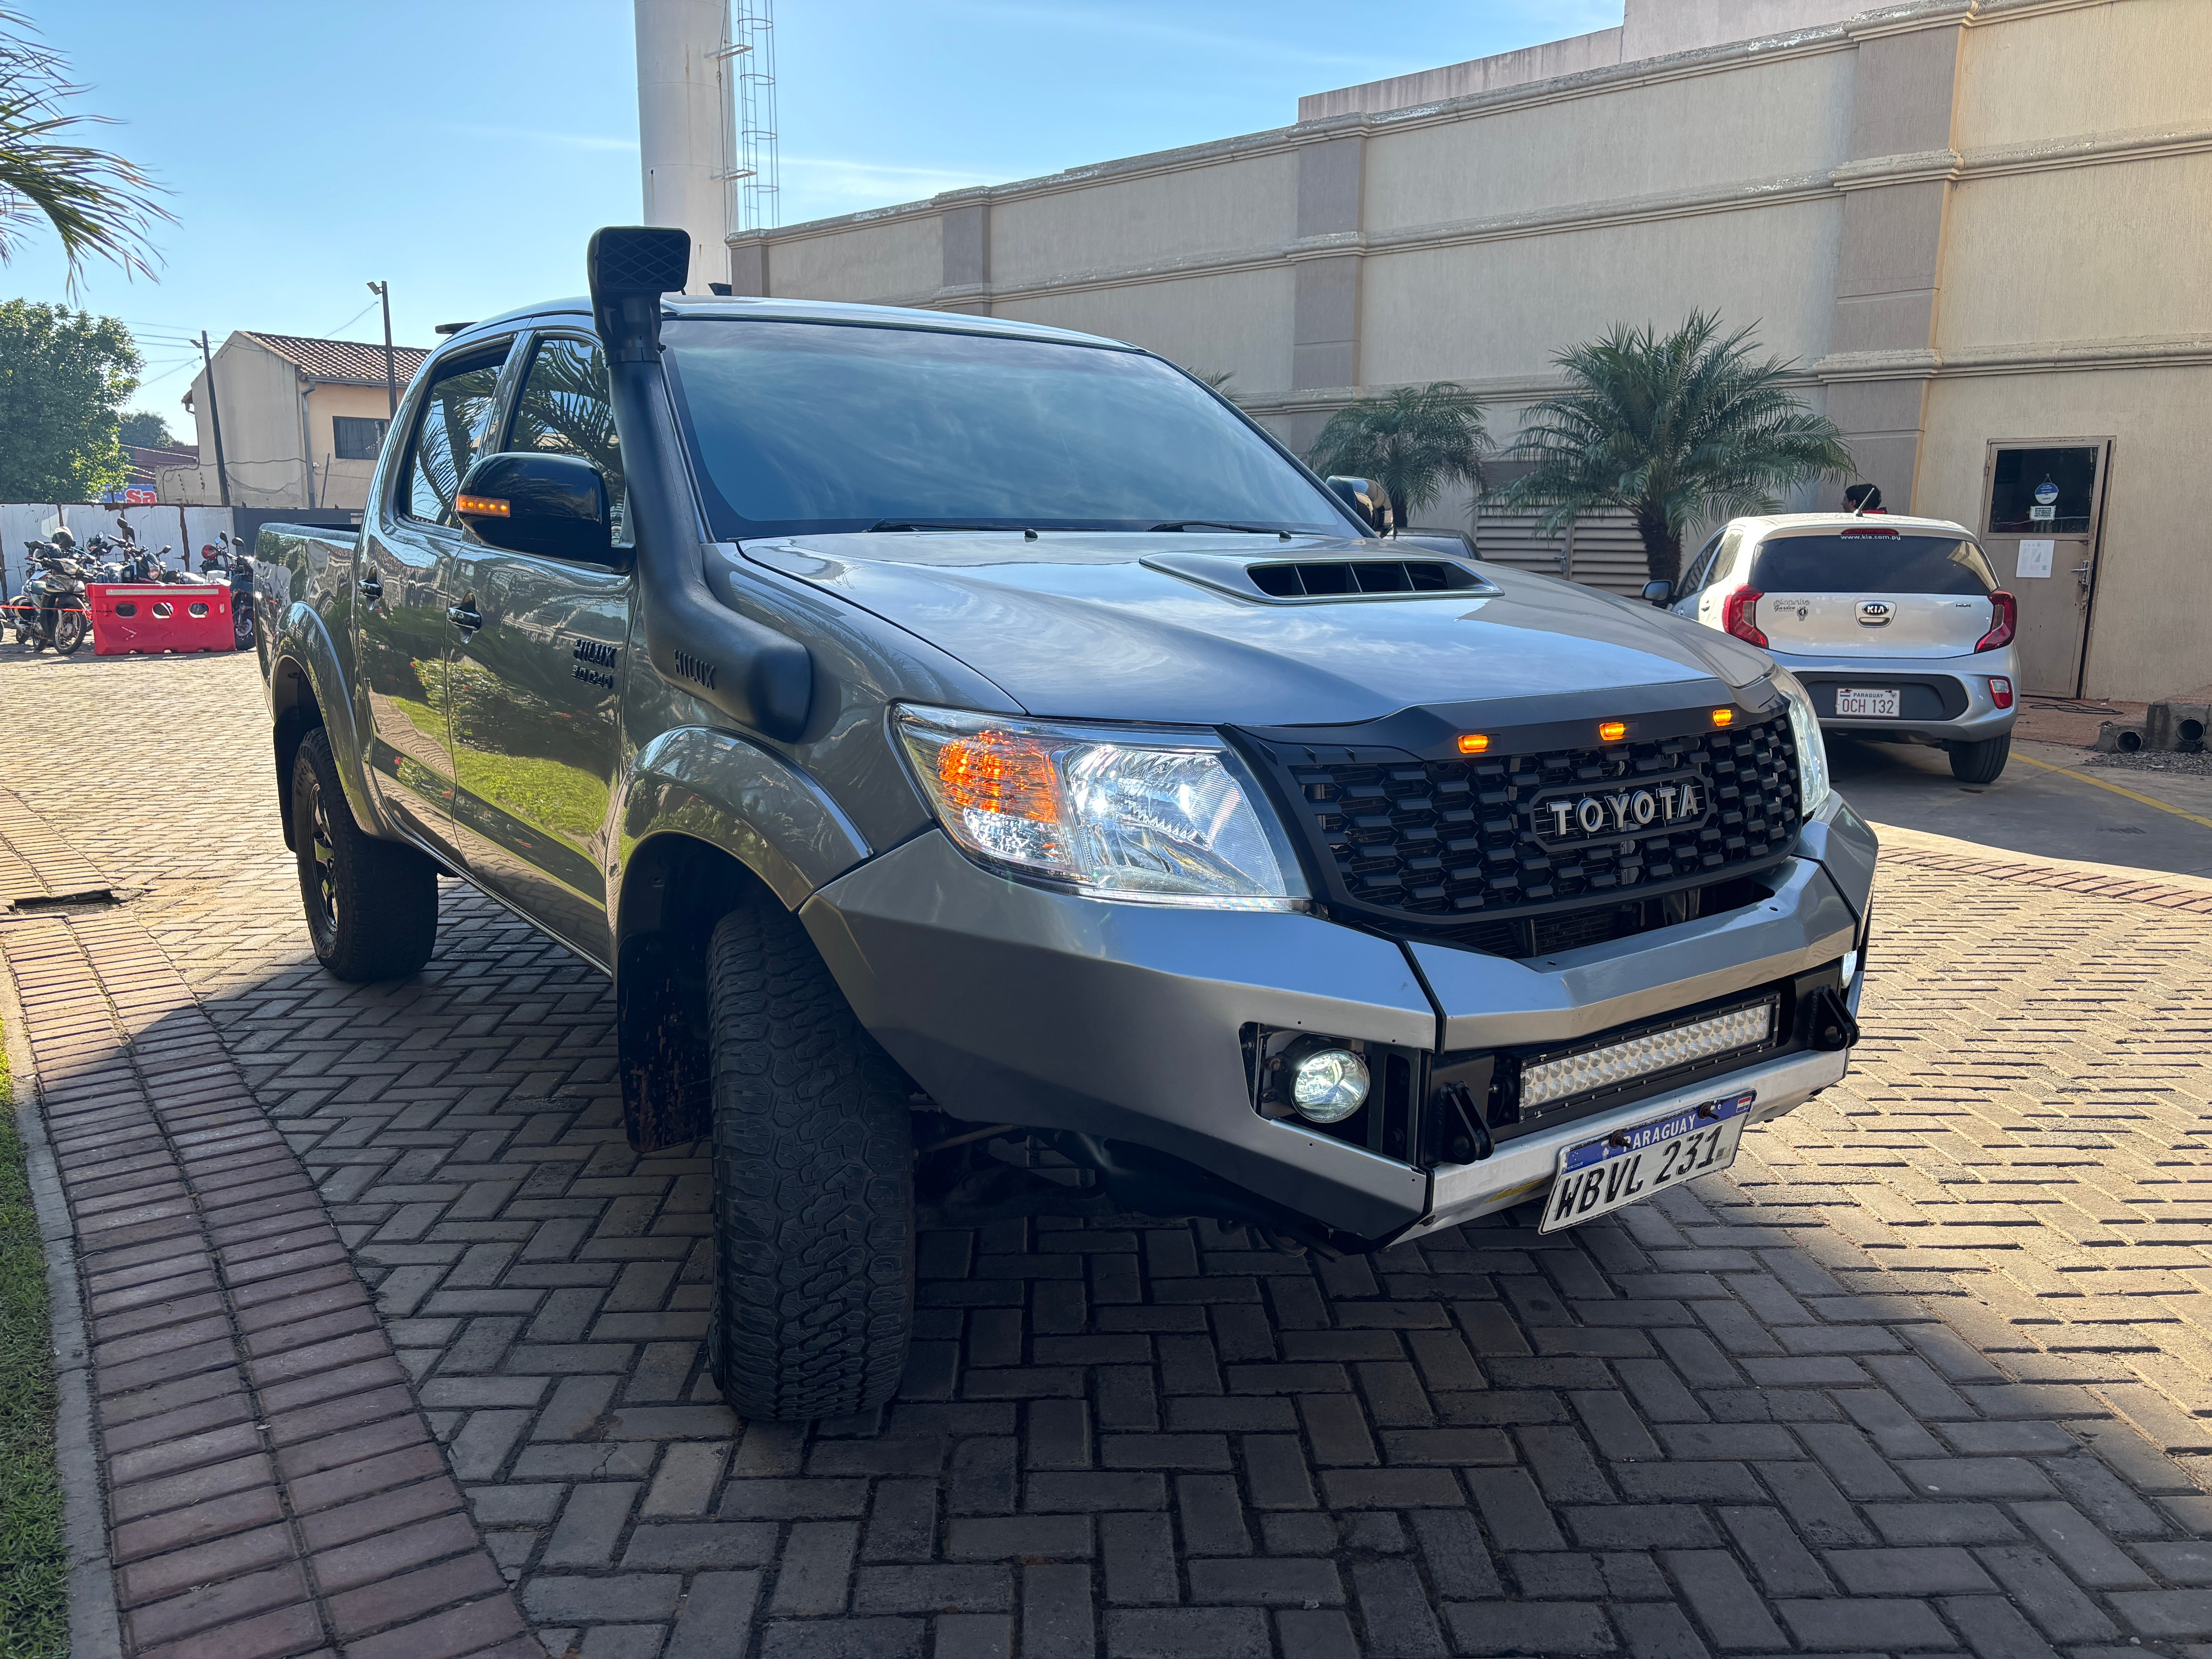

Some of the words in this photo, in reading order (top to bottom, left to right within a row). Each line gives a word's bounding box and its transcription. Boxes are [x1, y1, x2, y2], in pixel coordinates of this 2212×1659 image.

[573, 638, 618, 668] HILUX
[674, 649, 716, 690] HILUX
[1843, 699, 1865, 712] OCH
[1872, 699, 1893, 714] 132
[1547, 784, 1698, 836] TOYOTA
[1623, 1114, 1696, 1152] PARAGUAY
[1554, 1152, 1644, 1221] WBVL
[1654, 1125, 1723, 1185] 231
